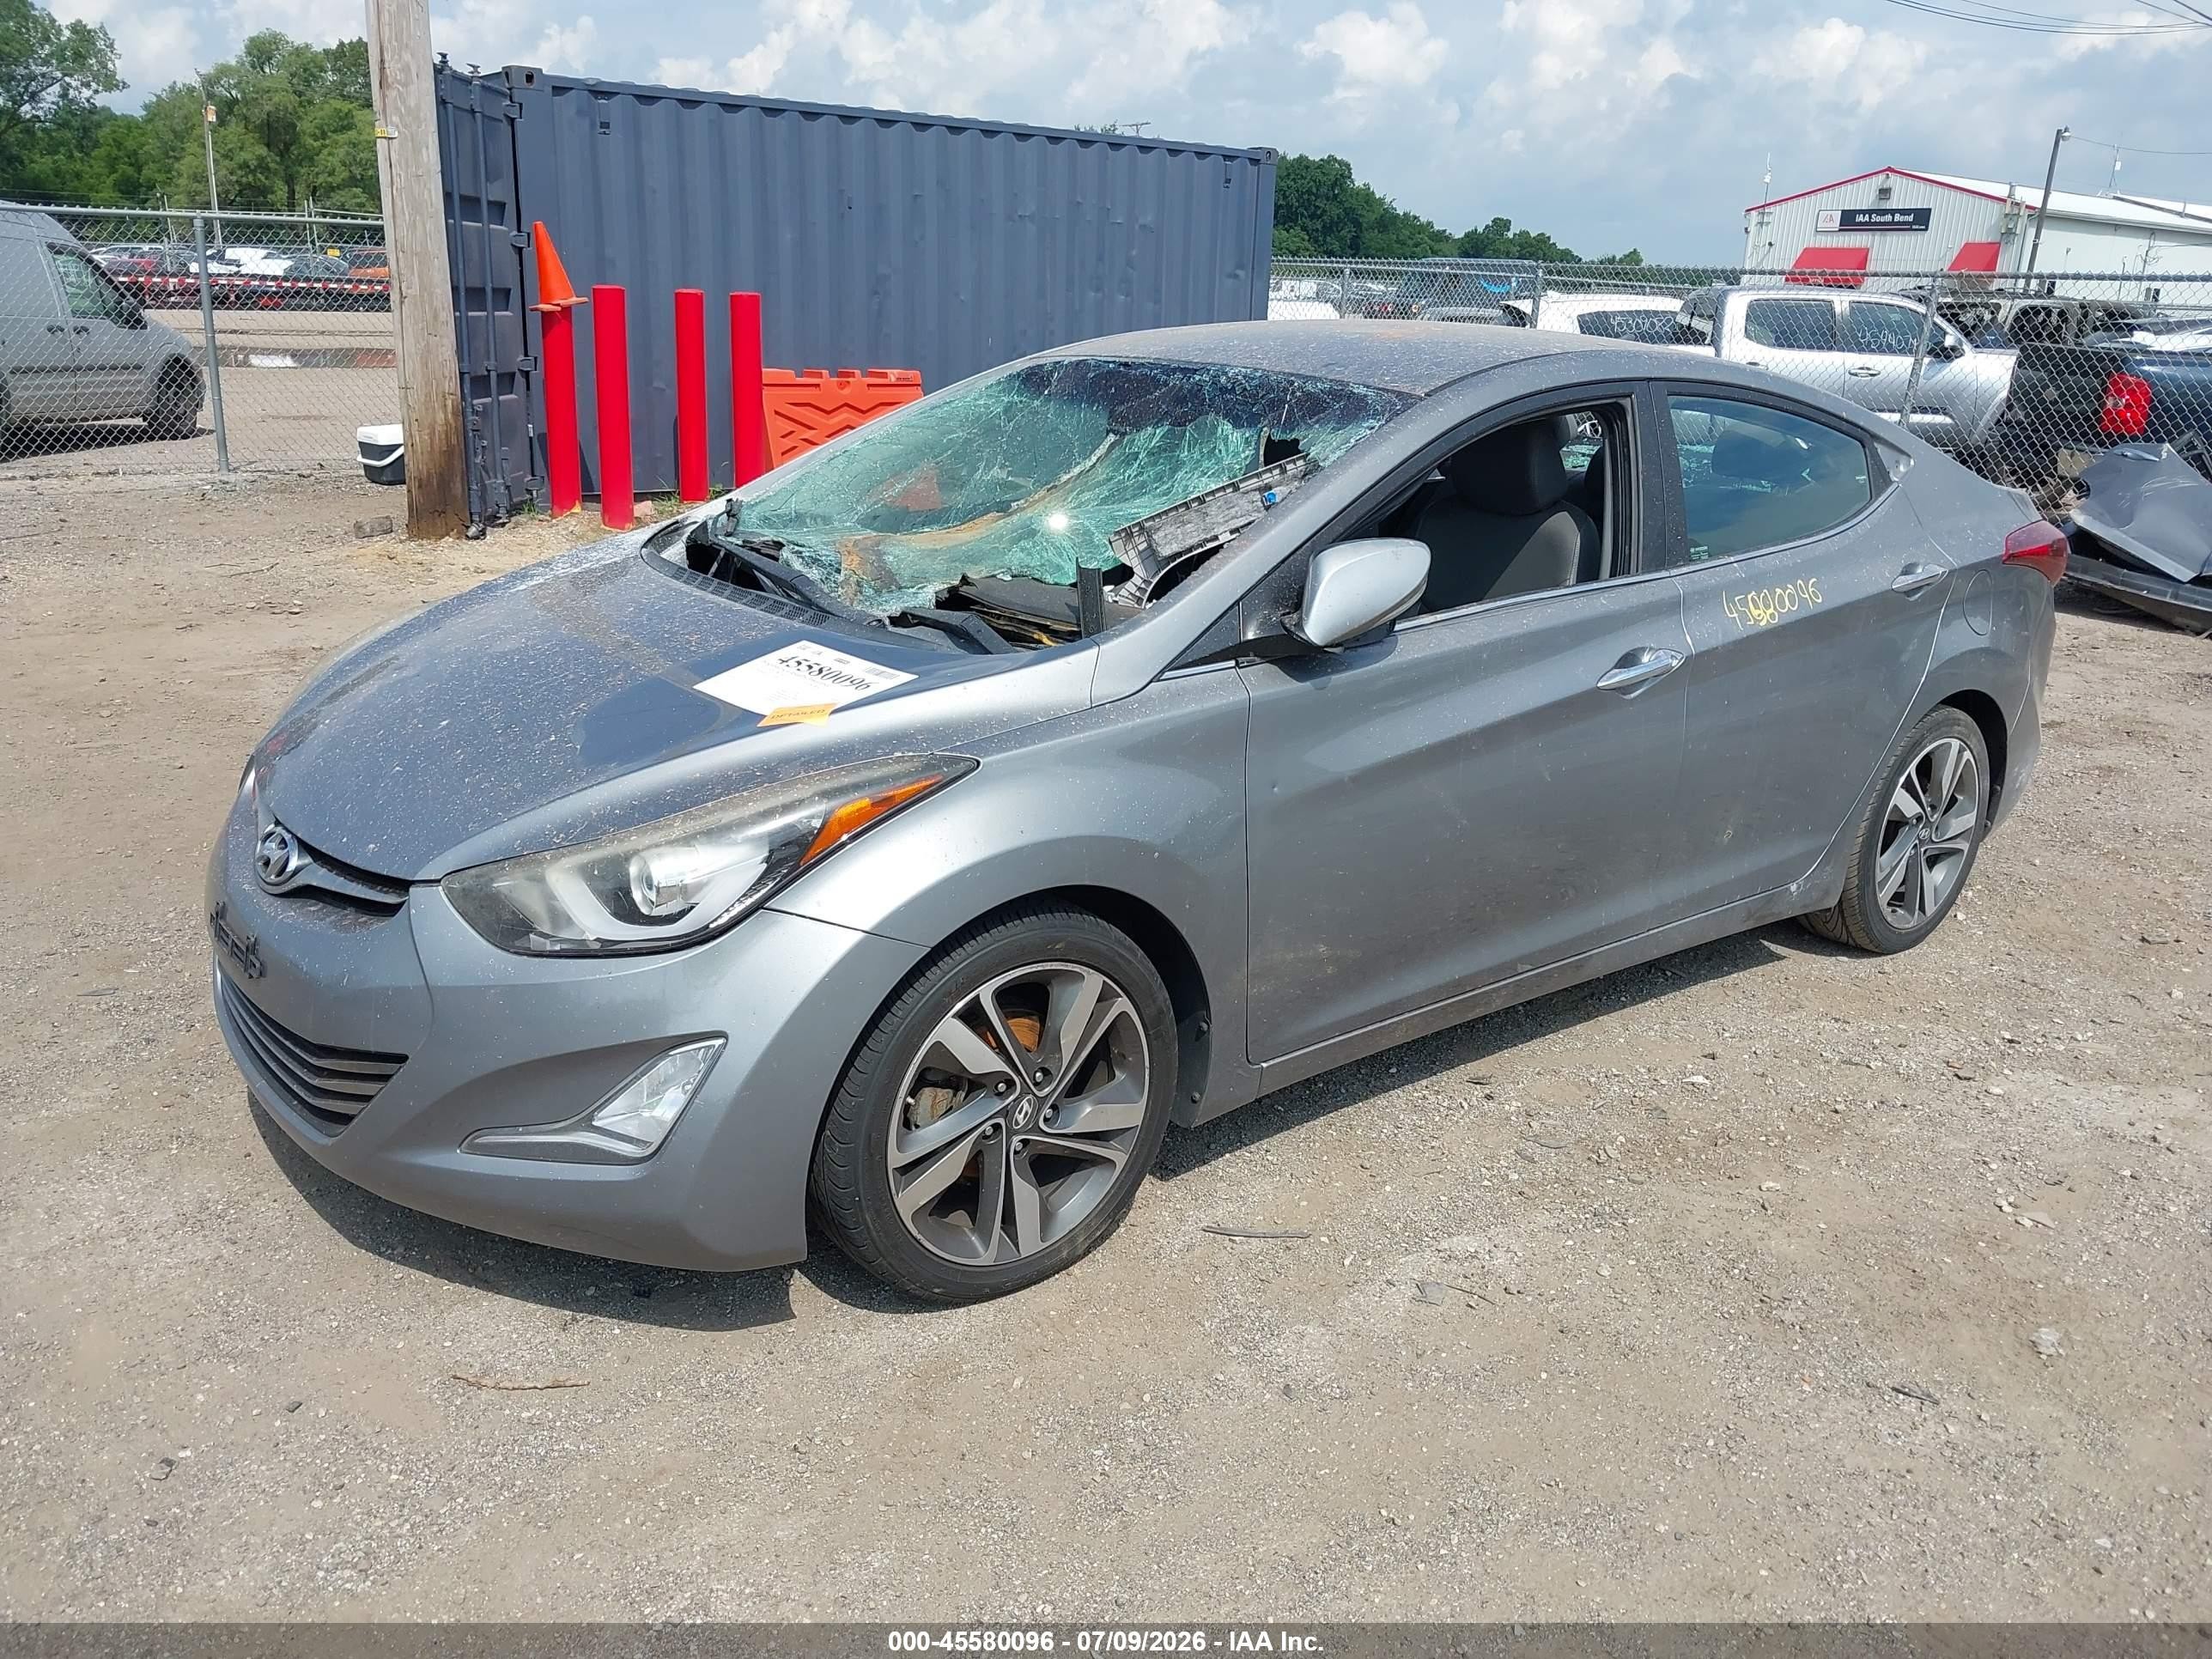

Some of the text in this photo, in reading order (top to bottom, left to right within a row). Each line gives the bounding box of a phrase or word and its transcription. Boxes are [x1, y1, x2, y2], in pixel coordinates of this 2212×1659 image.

[1855, 212, 1914, 222] IAA South Bend
[777, 655, 874, 691] 45580096
